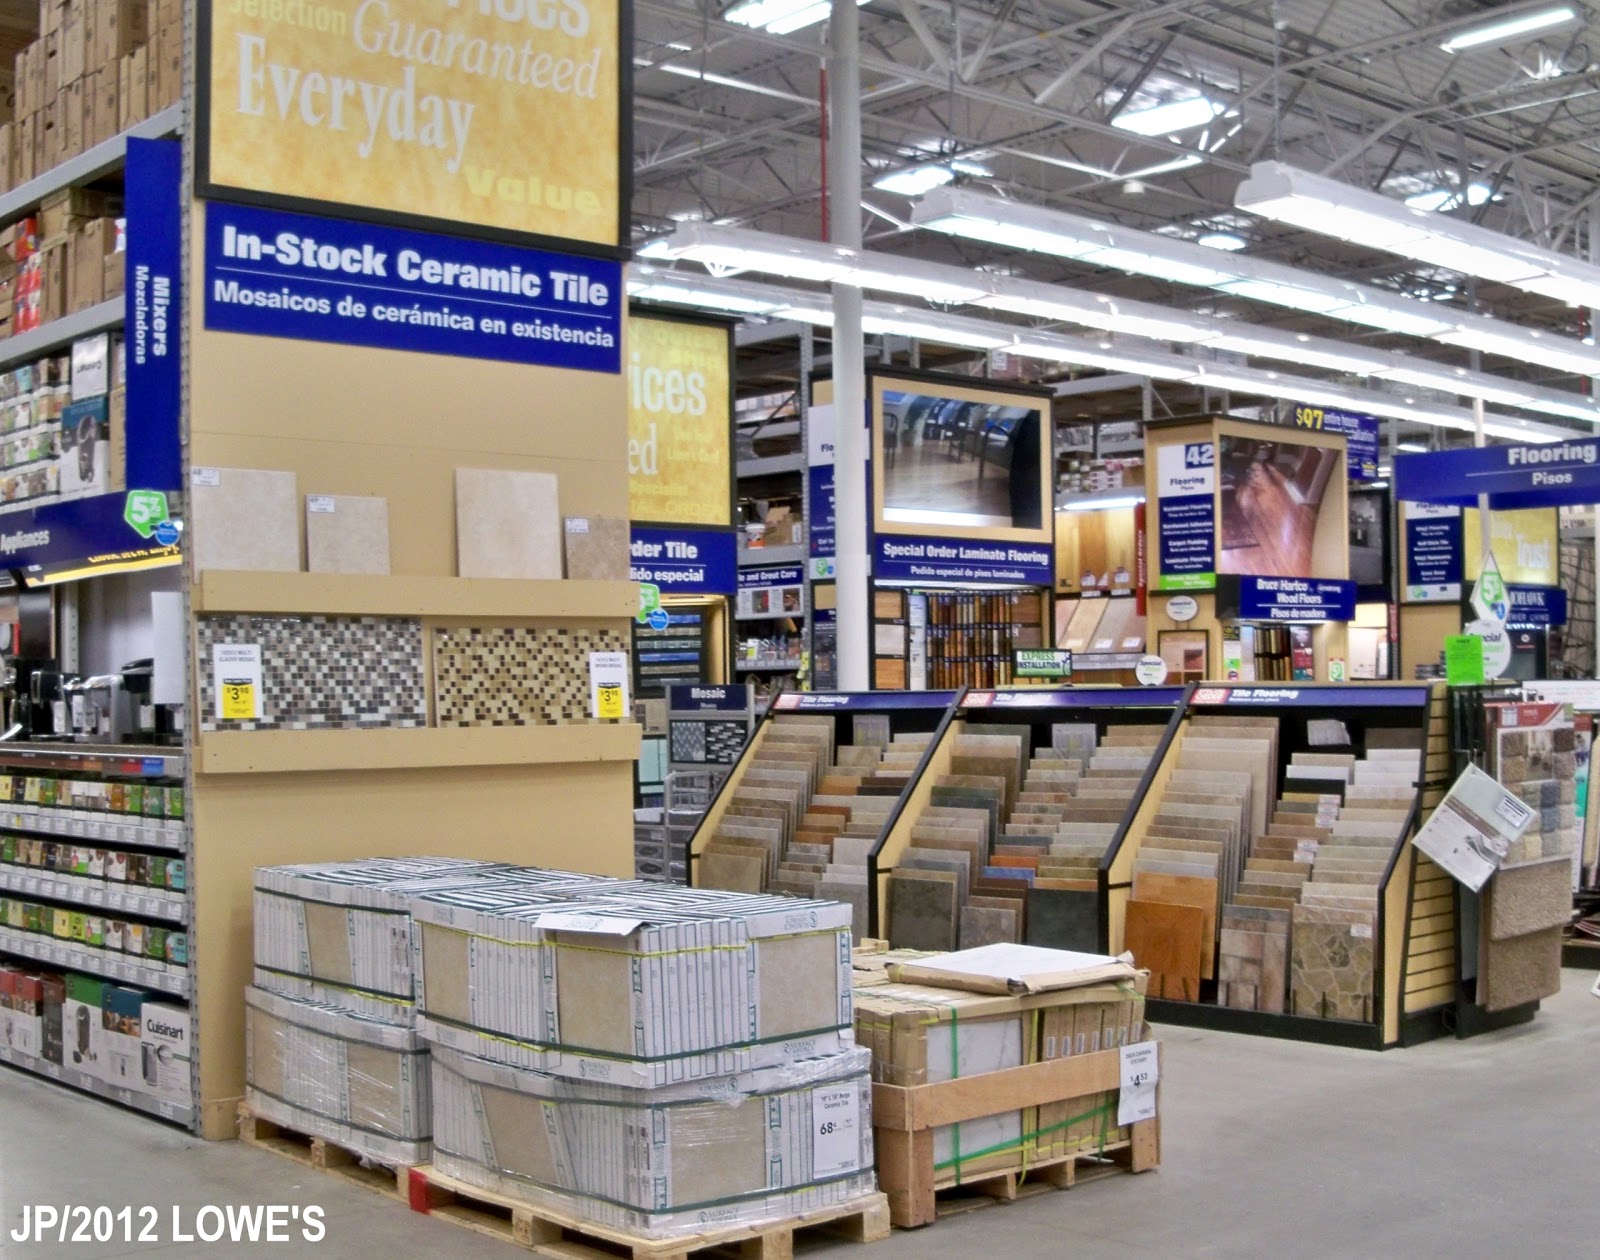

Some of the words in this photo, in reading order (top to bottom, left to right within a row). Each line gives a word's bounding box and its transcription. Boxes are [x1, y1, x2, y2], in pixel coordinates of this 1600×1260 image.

[353, 0, 602, 99] Guaranteed
[236, 33, 476, 174] Everyday
[461, 165, 603, 213] Value
[222, 225, 388, 277] In-Stock
[397, 249, 541, 298] Ceramic
[549, 272, 610, 307] Tile
[153, 276, 171, 357] Mixers
[213, 280, 331, 315] Mosaicos
[336, 295, 367, 318] de
[371, 303, 475, 333] cerámica
[479, 317, 507, 335] en
[511, 320, 614, 349] existencia
[1295, 407, 1324, 430] $97
[1186, 443, 1214, 465] 42
[1508, 443, 1597, 466] Flooring
[1170, 476, 1205, 486] Flooring
[1532, 472, 1573, 486] Pisos
[664, 541, 698, 559] Tile
[883, 543, 925, 558] Special
[926, 545, 957, 558] Order
[959, 547, 1006, 560] Laminate
[1008, 549, 1049, 565] Flooring
[654, 569, 704, 583] especial
[746, 573, 759, 582] and
[780, 570, 797, 579] Care
[910, 566, 935, 575] Pedido
[936, 567, 964, 578] especial
[964, 568, 973, 577] de
[1257, 578, 1278, 590] Bruce
[1277, 592, 1298, 603] Wood
[1299, 593, 1322, 604] Floors
[1271, 607, 1290, 618] Pisos
[1290, 608, 1300, 618] de
[1022, 651, 1055, 661] EXPRESS
[1018, 661, 1061, 669] INSTALLATION
[691, 688, 726, 699] Mosaic
[1252, 689, 1299, 699] Flooring
[147, 1018, 184, 1040] Cuisinart
